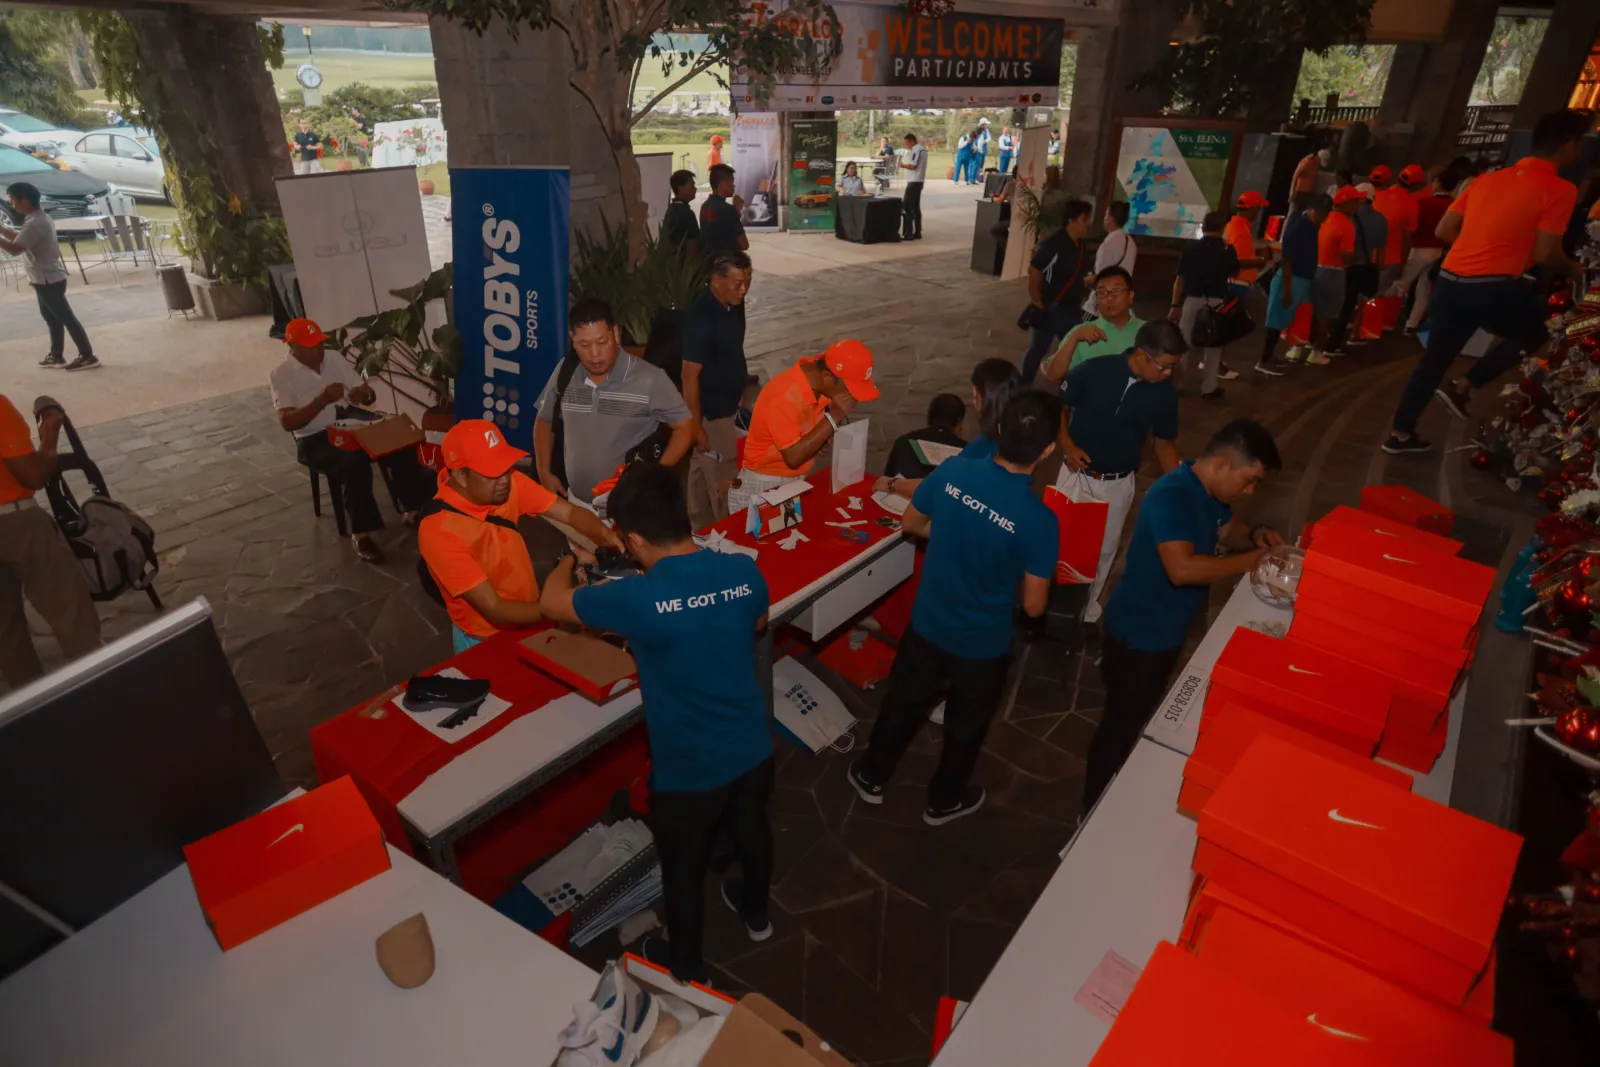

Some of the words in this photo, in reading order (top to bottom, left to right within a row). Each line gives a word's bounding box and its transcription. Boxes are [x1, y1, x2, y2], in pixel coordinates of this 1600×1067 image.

[885, 13, 1043, 60] WELCOME!
[894, 57, 1032, 79] PARTICIPANTS
[1196, 134, 1227, 145] ELENA
[526, 290, 538, 349] SPORTS
[945, 482, 962, 500] WE
[962, 494, 988, 514] GOT
[988, 508, 1015, 534] THIS.
[655, 598, 683, 614] WE
[687, 592, 717, 609] GOT
[720, 583, 753, 602] THIS.
[1164, 675, 1201, 722] BQ8928-015
